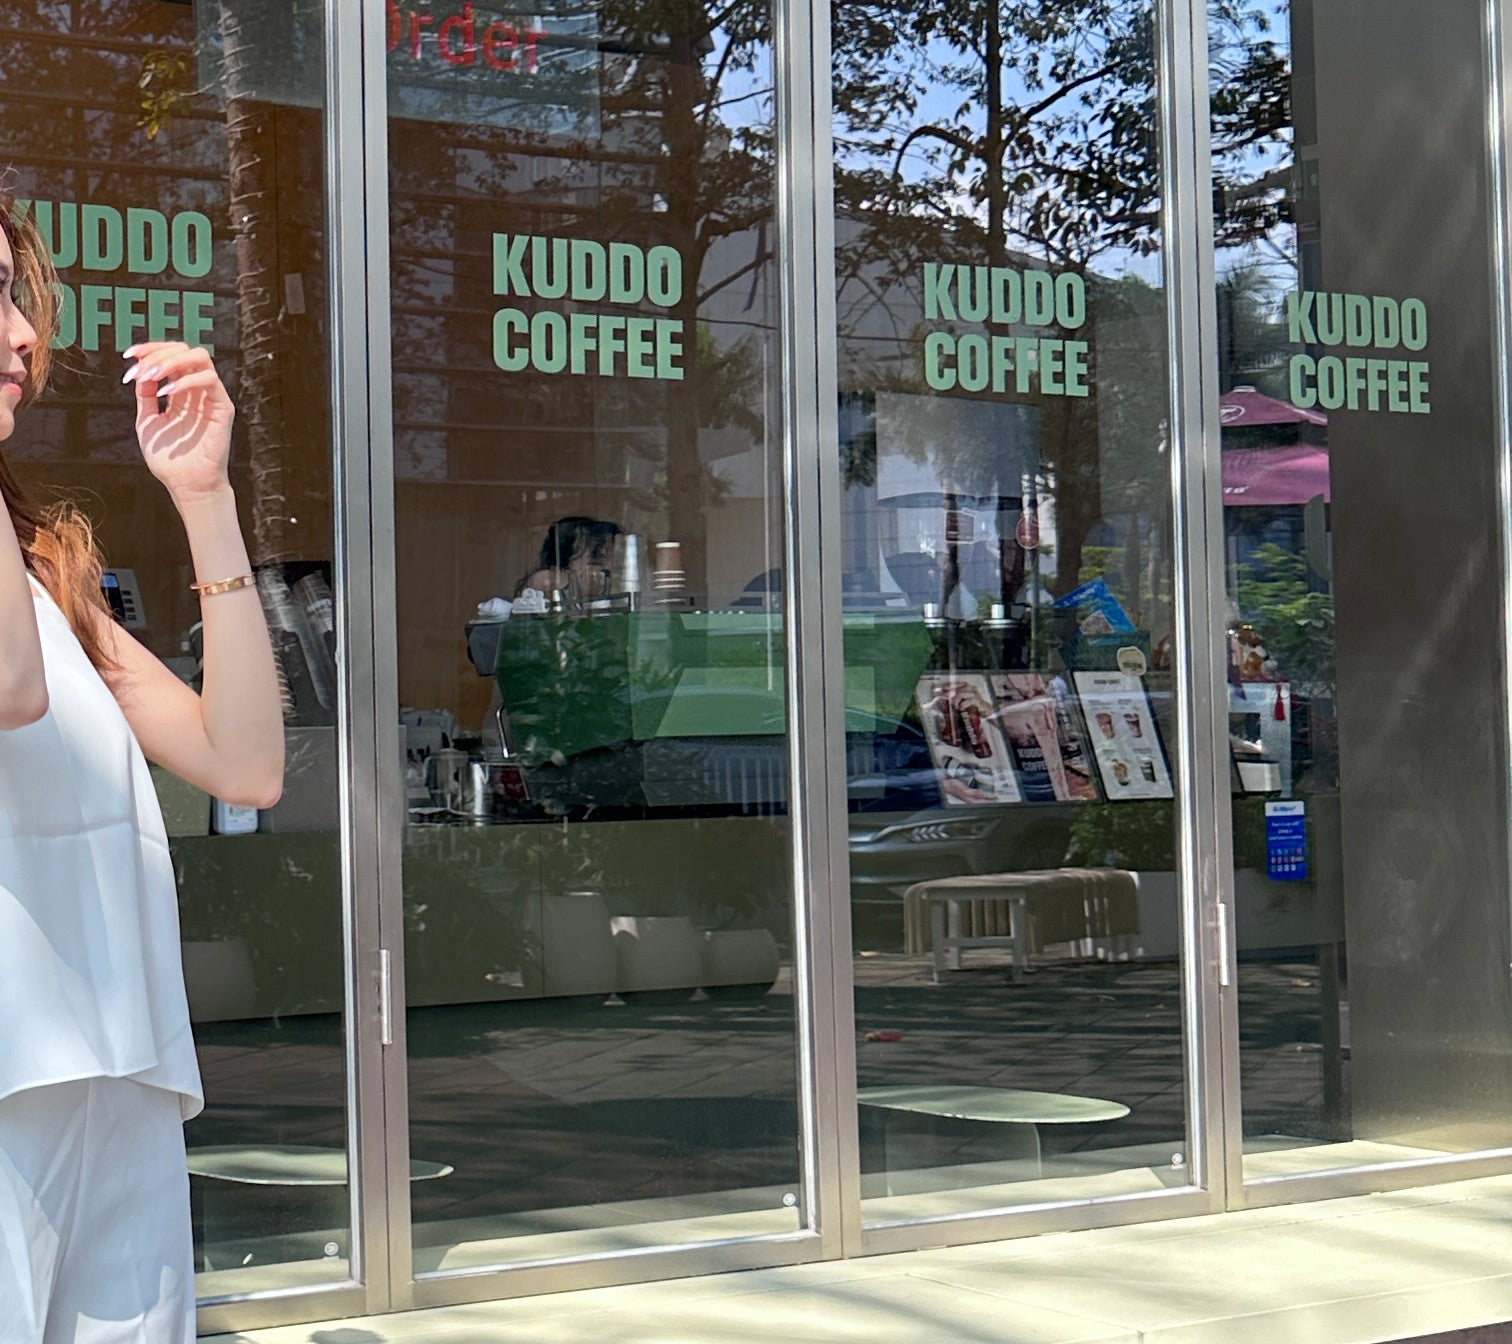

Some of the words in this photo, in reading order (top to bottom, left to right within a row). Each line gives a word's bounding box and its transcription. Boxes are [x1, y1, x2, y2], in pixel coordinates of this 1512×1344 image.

[492, 233, 682, 307] KUDDO
[923, 261, 1086, 329] KUDDO
[44, 280, 215, 357] OFFEE
[493, 308, 684, 380] COFFEE
[1286, 290, 1428, 350] KUDDO
[924, 330, 1089, 397] COFFEE
[1288, 353, 1431, 413] COFFEE
